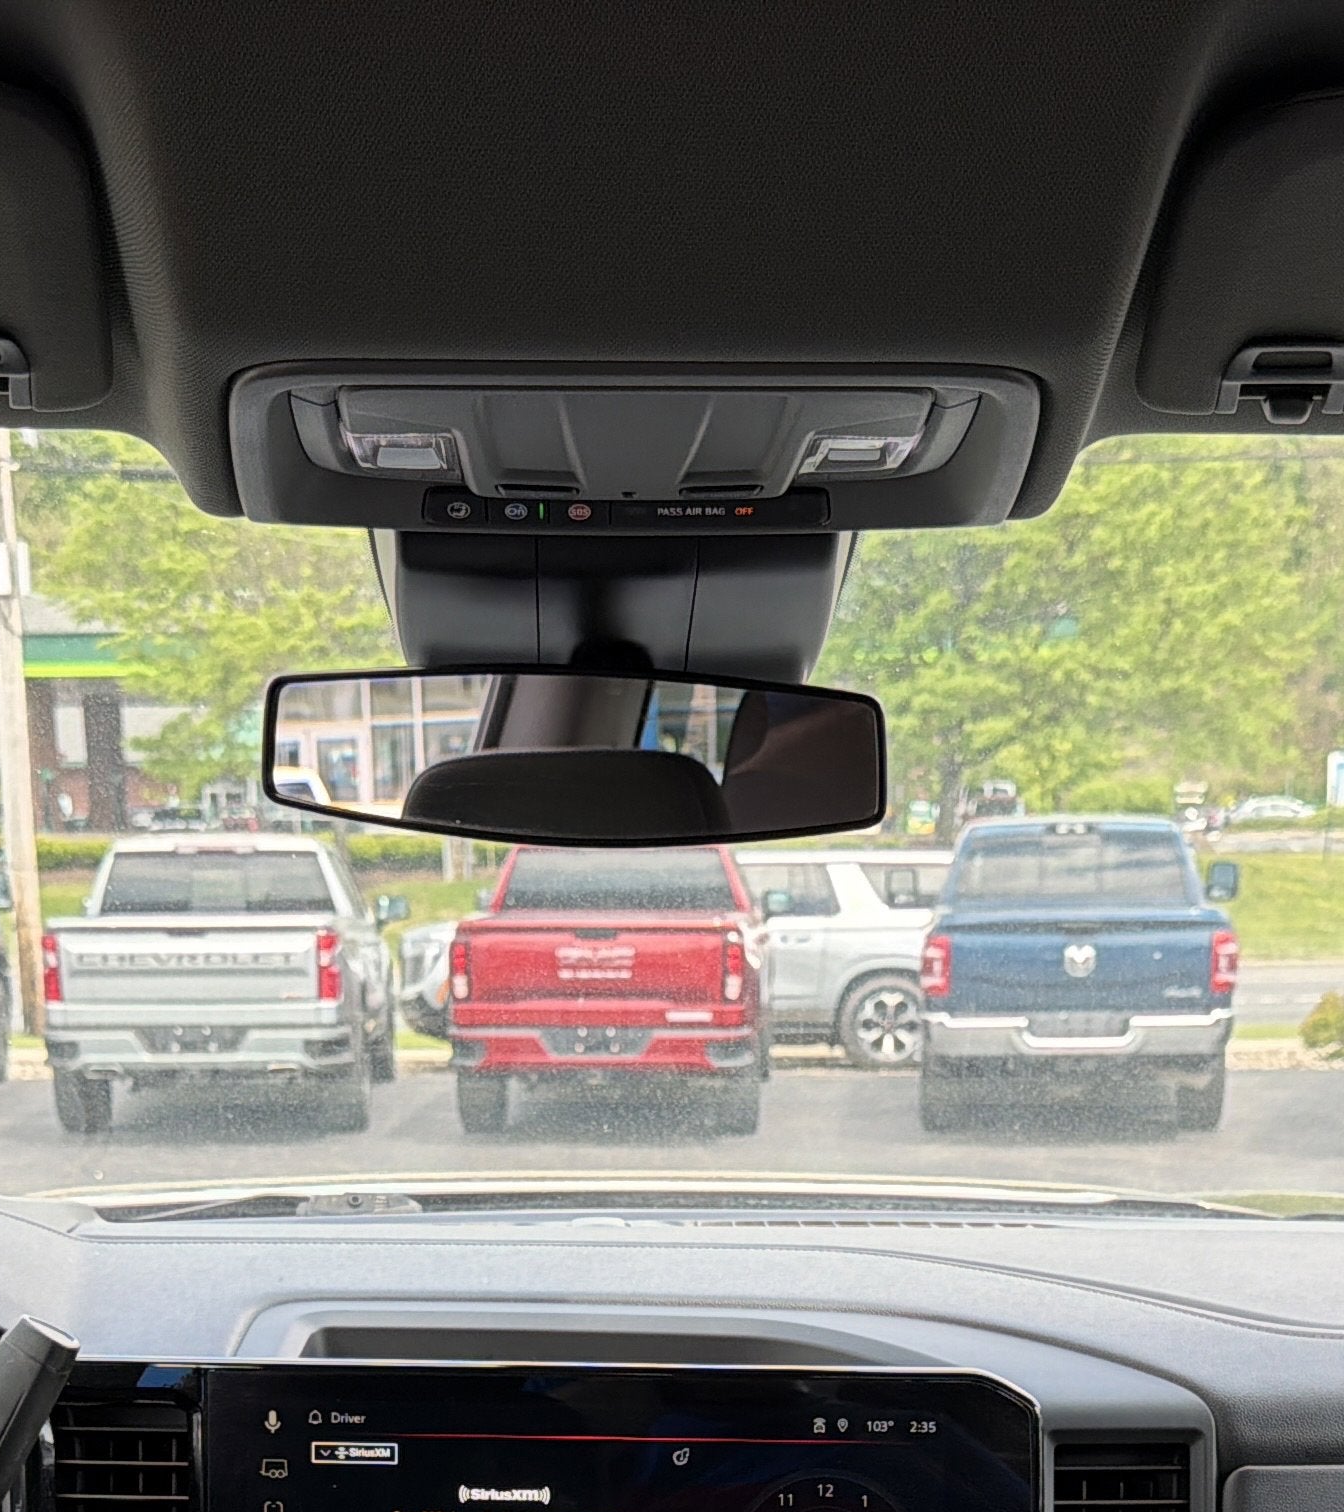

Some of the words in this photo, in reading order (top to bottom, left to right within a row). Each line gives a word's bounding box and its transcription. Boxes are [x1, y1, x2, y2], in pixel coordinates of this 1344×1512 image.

[570, 507, 590, 517] SOS
[657, 507, 683, 517] PASS
[685, 507, 703, 517] AIR
[705, 507, 726, 517] BAG
[735, 506, 754, 516] OFF
[76, 953, 297, 969] CHEVROLET
[331, 1411, 366, 1424] Driver
[866, 1420, 895, 1433] 103°
[909, 1421, 936, 1433] 2:35
[817, 1484, 834, 1498] 12
[778, 1493, 794, 1507] 11
[861, 1495, 868, 1508] 1
